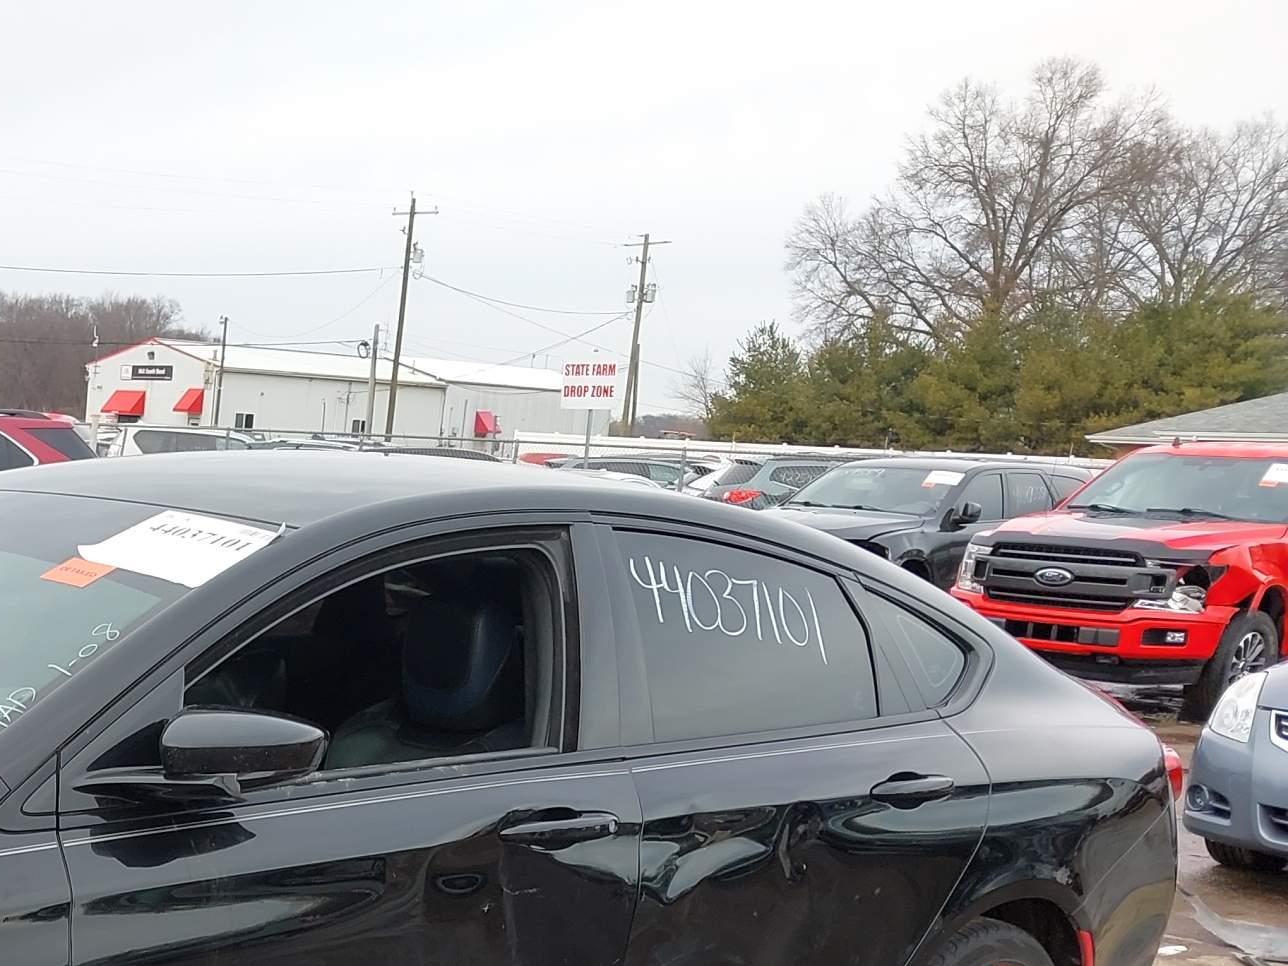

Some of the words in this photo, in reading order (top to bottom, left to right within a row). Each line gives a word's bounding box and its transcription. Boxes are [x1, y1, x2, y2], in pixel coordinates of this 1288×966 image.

[564, 364, 590, 376] STATE
[592, 364, 616, 376] FARM
[563, 385, 589, 398] DROP
[591, 385, 615, 398] ZONE
[149, 523, 253, 551] 44037101
[630, 556, 828, 665] 44037101
